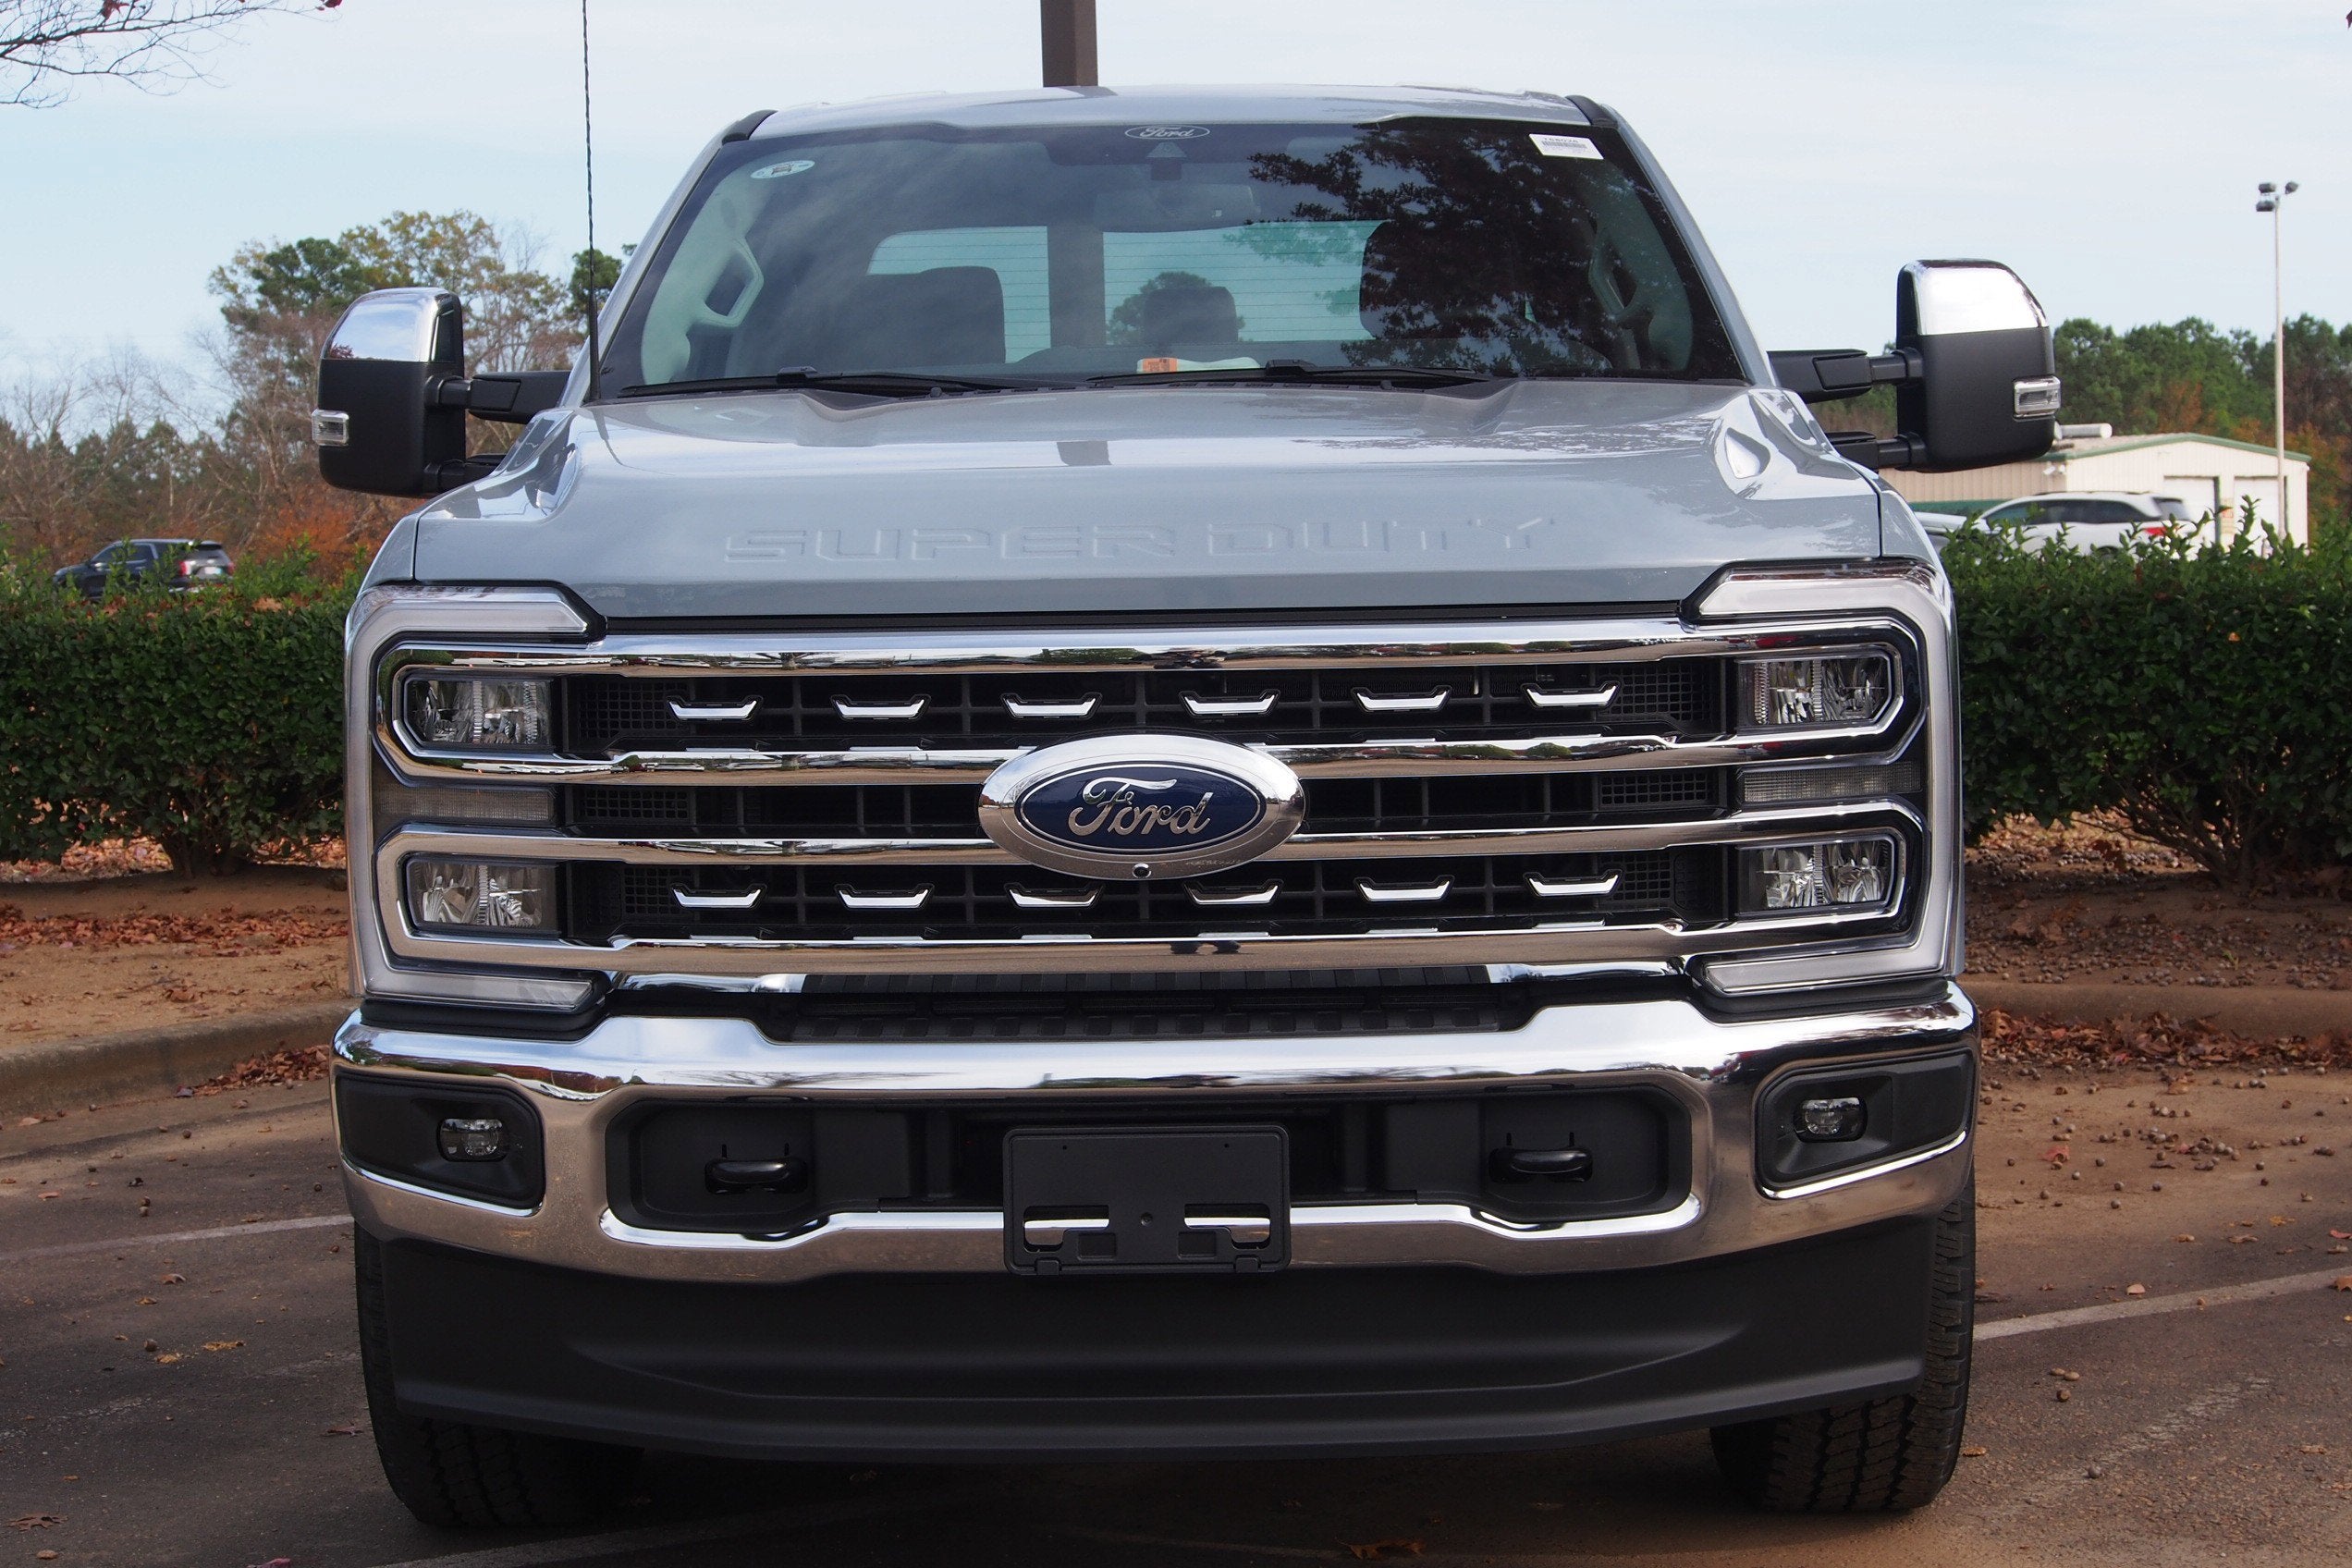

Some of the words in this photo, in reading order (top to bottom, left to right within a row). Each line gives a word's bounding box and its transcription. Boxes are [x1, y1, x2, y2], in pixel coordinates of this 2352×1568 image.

[1140, 127, 1194, 138] Ford
[725, 525, 1176, 562] SUPER
[1207, 516, 1555, 555] DUTY
[1068, 777, 1213, 837] Ford
